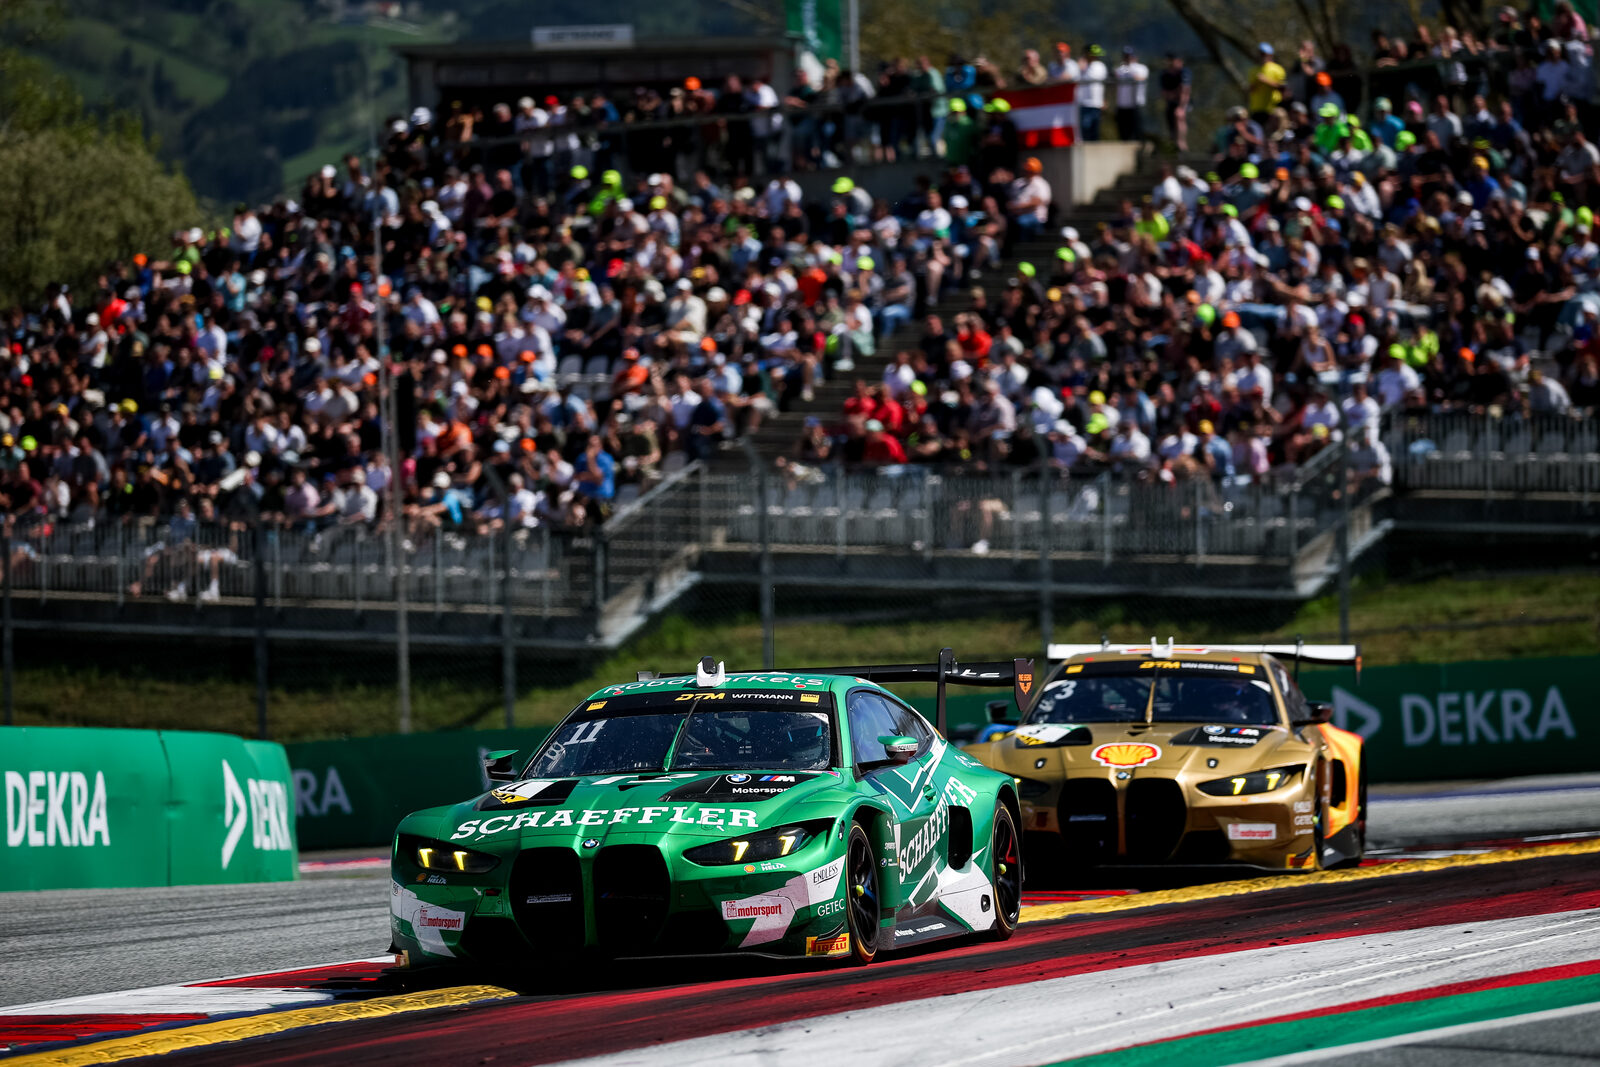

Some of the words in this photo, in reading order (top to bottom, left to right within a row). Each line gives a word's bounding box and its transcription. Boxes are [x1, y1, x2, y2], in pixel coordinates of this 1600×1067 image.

[603, 675, 824, 694] Roborkets
[1054, 680, 1077, 700] 3
[674, 692, 726, 702] DTM
[1400, 684, 1577, 746] DEKRA
[563, 719, 608, 746] 11
[5, 770, 111, 847] DEKRA
[450, 806, 759, 841] SCHAEFFLER
[761, 863, 787, 871] HELIX
[813, 863, 838, 884] ENDLESS
[737, 903, 782, 917] motorsport
[817, 898, 845, 917] GETEC
[428, 917, 461, 929] motorsport
[811, 936, 847, 952] PIRELLI
